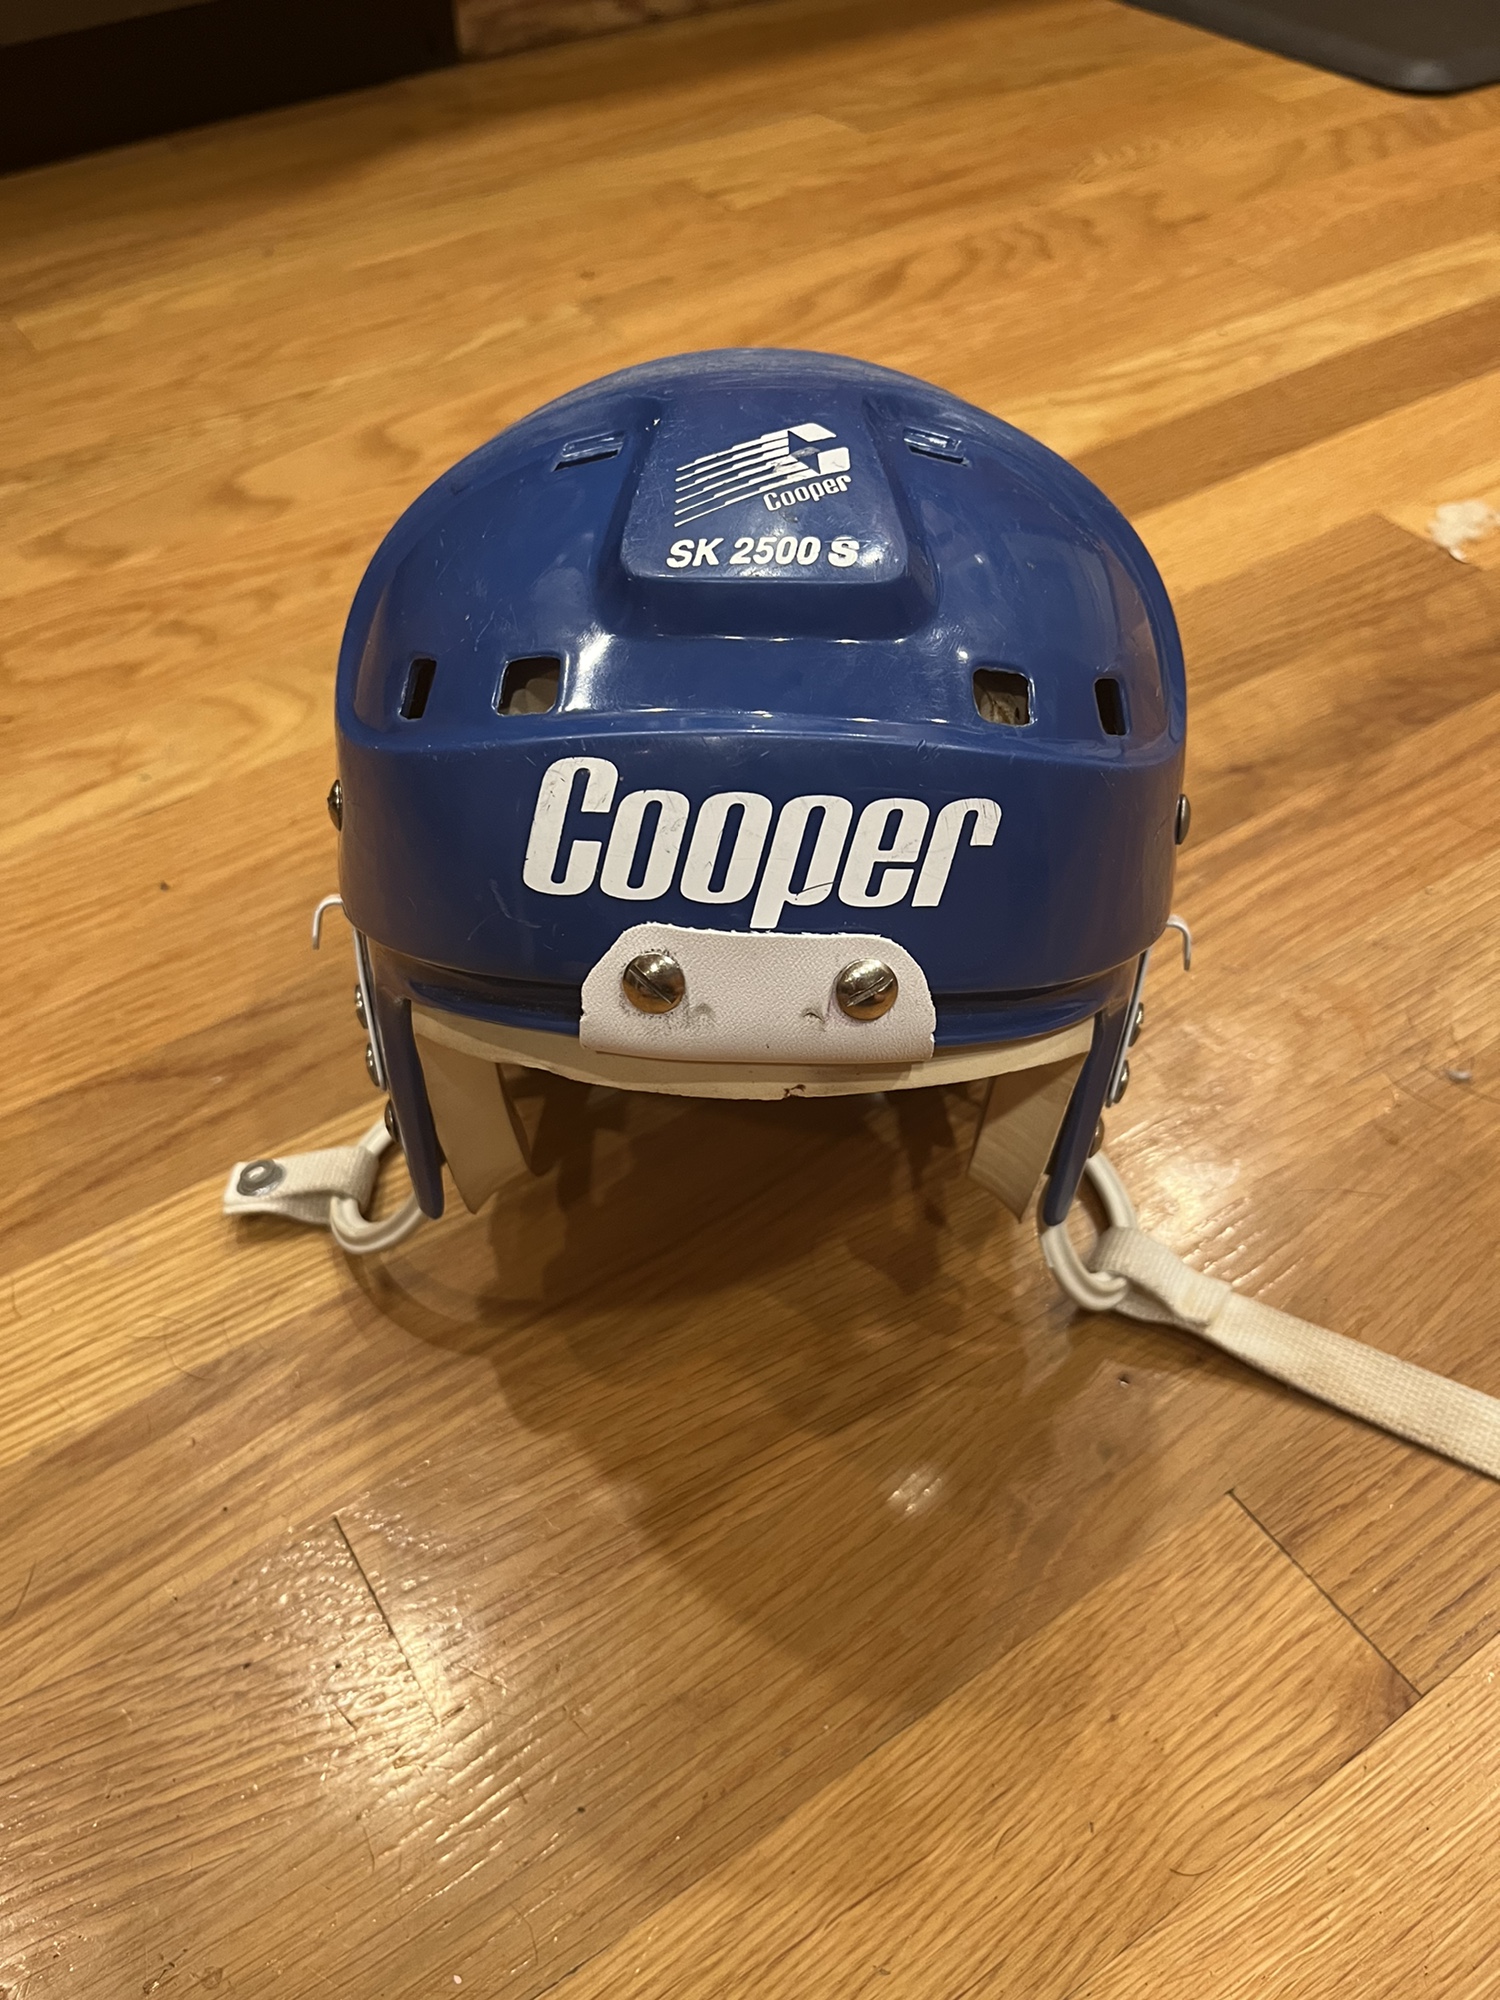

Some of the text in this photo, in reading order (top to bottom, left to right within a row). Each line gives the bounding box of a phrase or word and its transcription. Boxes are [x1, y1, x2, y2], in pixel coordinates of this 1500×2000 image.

[763, 474, 852, 512] Cooper
[666, 535, 860, 568] SK 2500 S
[522, 756, 1002, 929] Cooper
